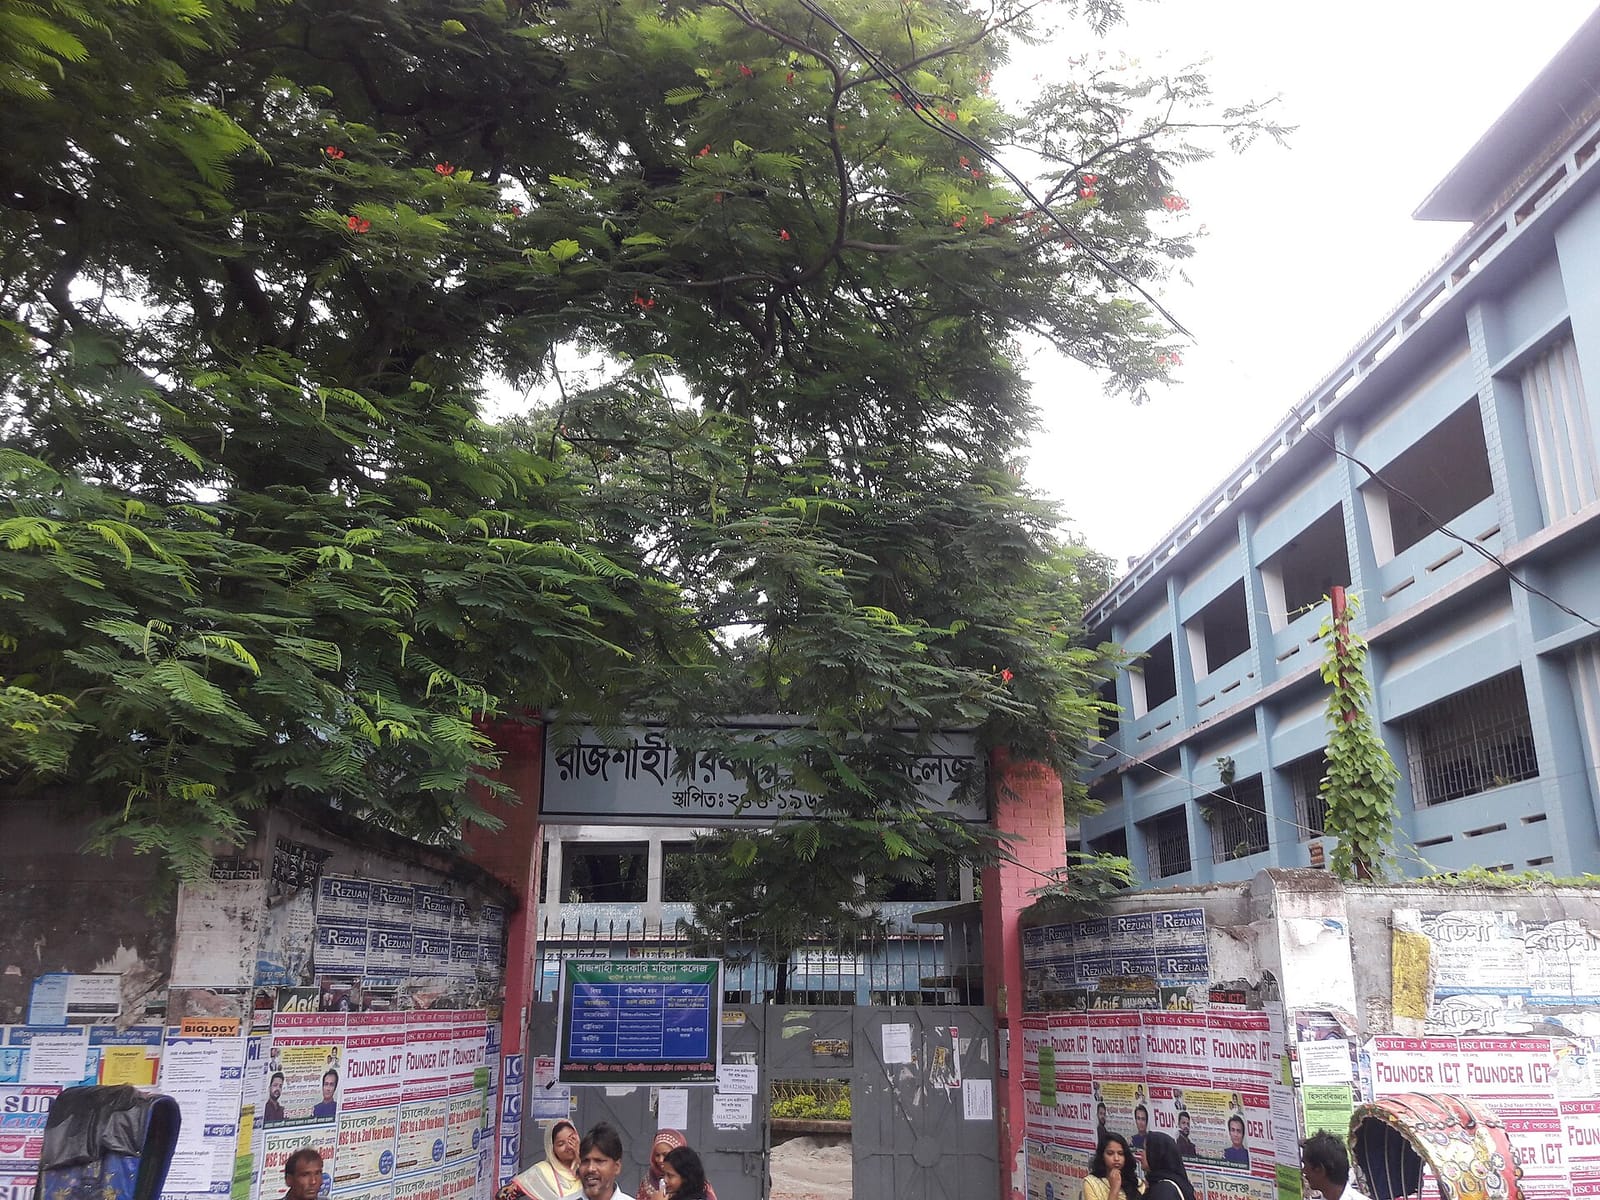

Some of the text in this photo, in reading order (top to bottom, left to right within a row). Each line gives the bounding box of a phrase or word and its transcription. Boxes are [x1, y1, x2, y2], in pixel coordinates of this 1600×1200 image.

[331, 881, 368, 899] REZUAN
[1117, 918, 1152, 931] REZUAN
[1163, 913, 1203, 928] REZUAN
[327, 929, 366, 945] REZUAN
[378, 933, 411, 949] REZUAN
[577, 961, 612, 974] রাজশাহী
[652, 962, 677, 974] মহিলা
[680, 963, 708, 974] কলেজ
[1121, 960, 1156, 974] REZUAN
[1167, 958, 1208, 974] REZUAN
[291, 1017, 303, 1025] ICT
[1155, 1016, 1166, 1024] ICT
[184, 1025, 236, 1033] BIOLOGY
[1077, 1035, 1088, 1052] ICT
[1092, 1036, 1140, 1054] FOUNDER ICT
[1147, 1034, 1206, 1055] FOUNDER ICT
[1212, 1039, 1270, 1061] FOUNDER ICT
[1376, 1040, 1389, 1049] SC
[1391, 1041, 1406, 1049] ICT
[347, 1055, 402, 1078] FOUNDER ICT
[406, 1050, 450, 1070] FOUNDER ICT
[1376, 1062, 1461, 1083] FOUNDER ICT
[1467, 1063, 1551, 1084] FOUNDER ICT
[1307, 1091, 1348, 1101] হিসাববিজ্ঞান
[1080, 1102, 1092, 1120] ICT
[1154, 1108, 1176, 1129] FOUN
[338, 1131, 350, 1146] HSC
[1567, 1125, 1600, 1146] FOUN
[265, 1153, 279, 1168] HSC
[1541, 1143, 1563, 1164] ICT
[1592, 1185, 1600, 1193] IC
